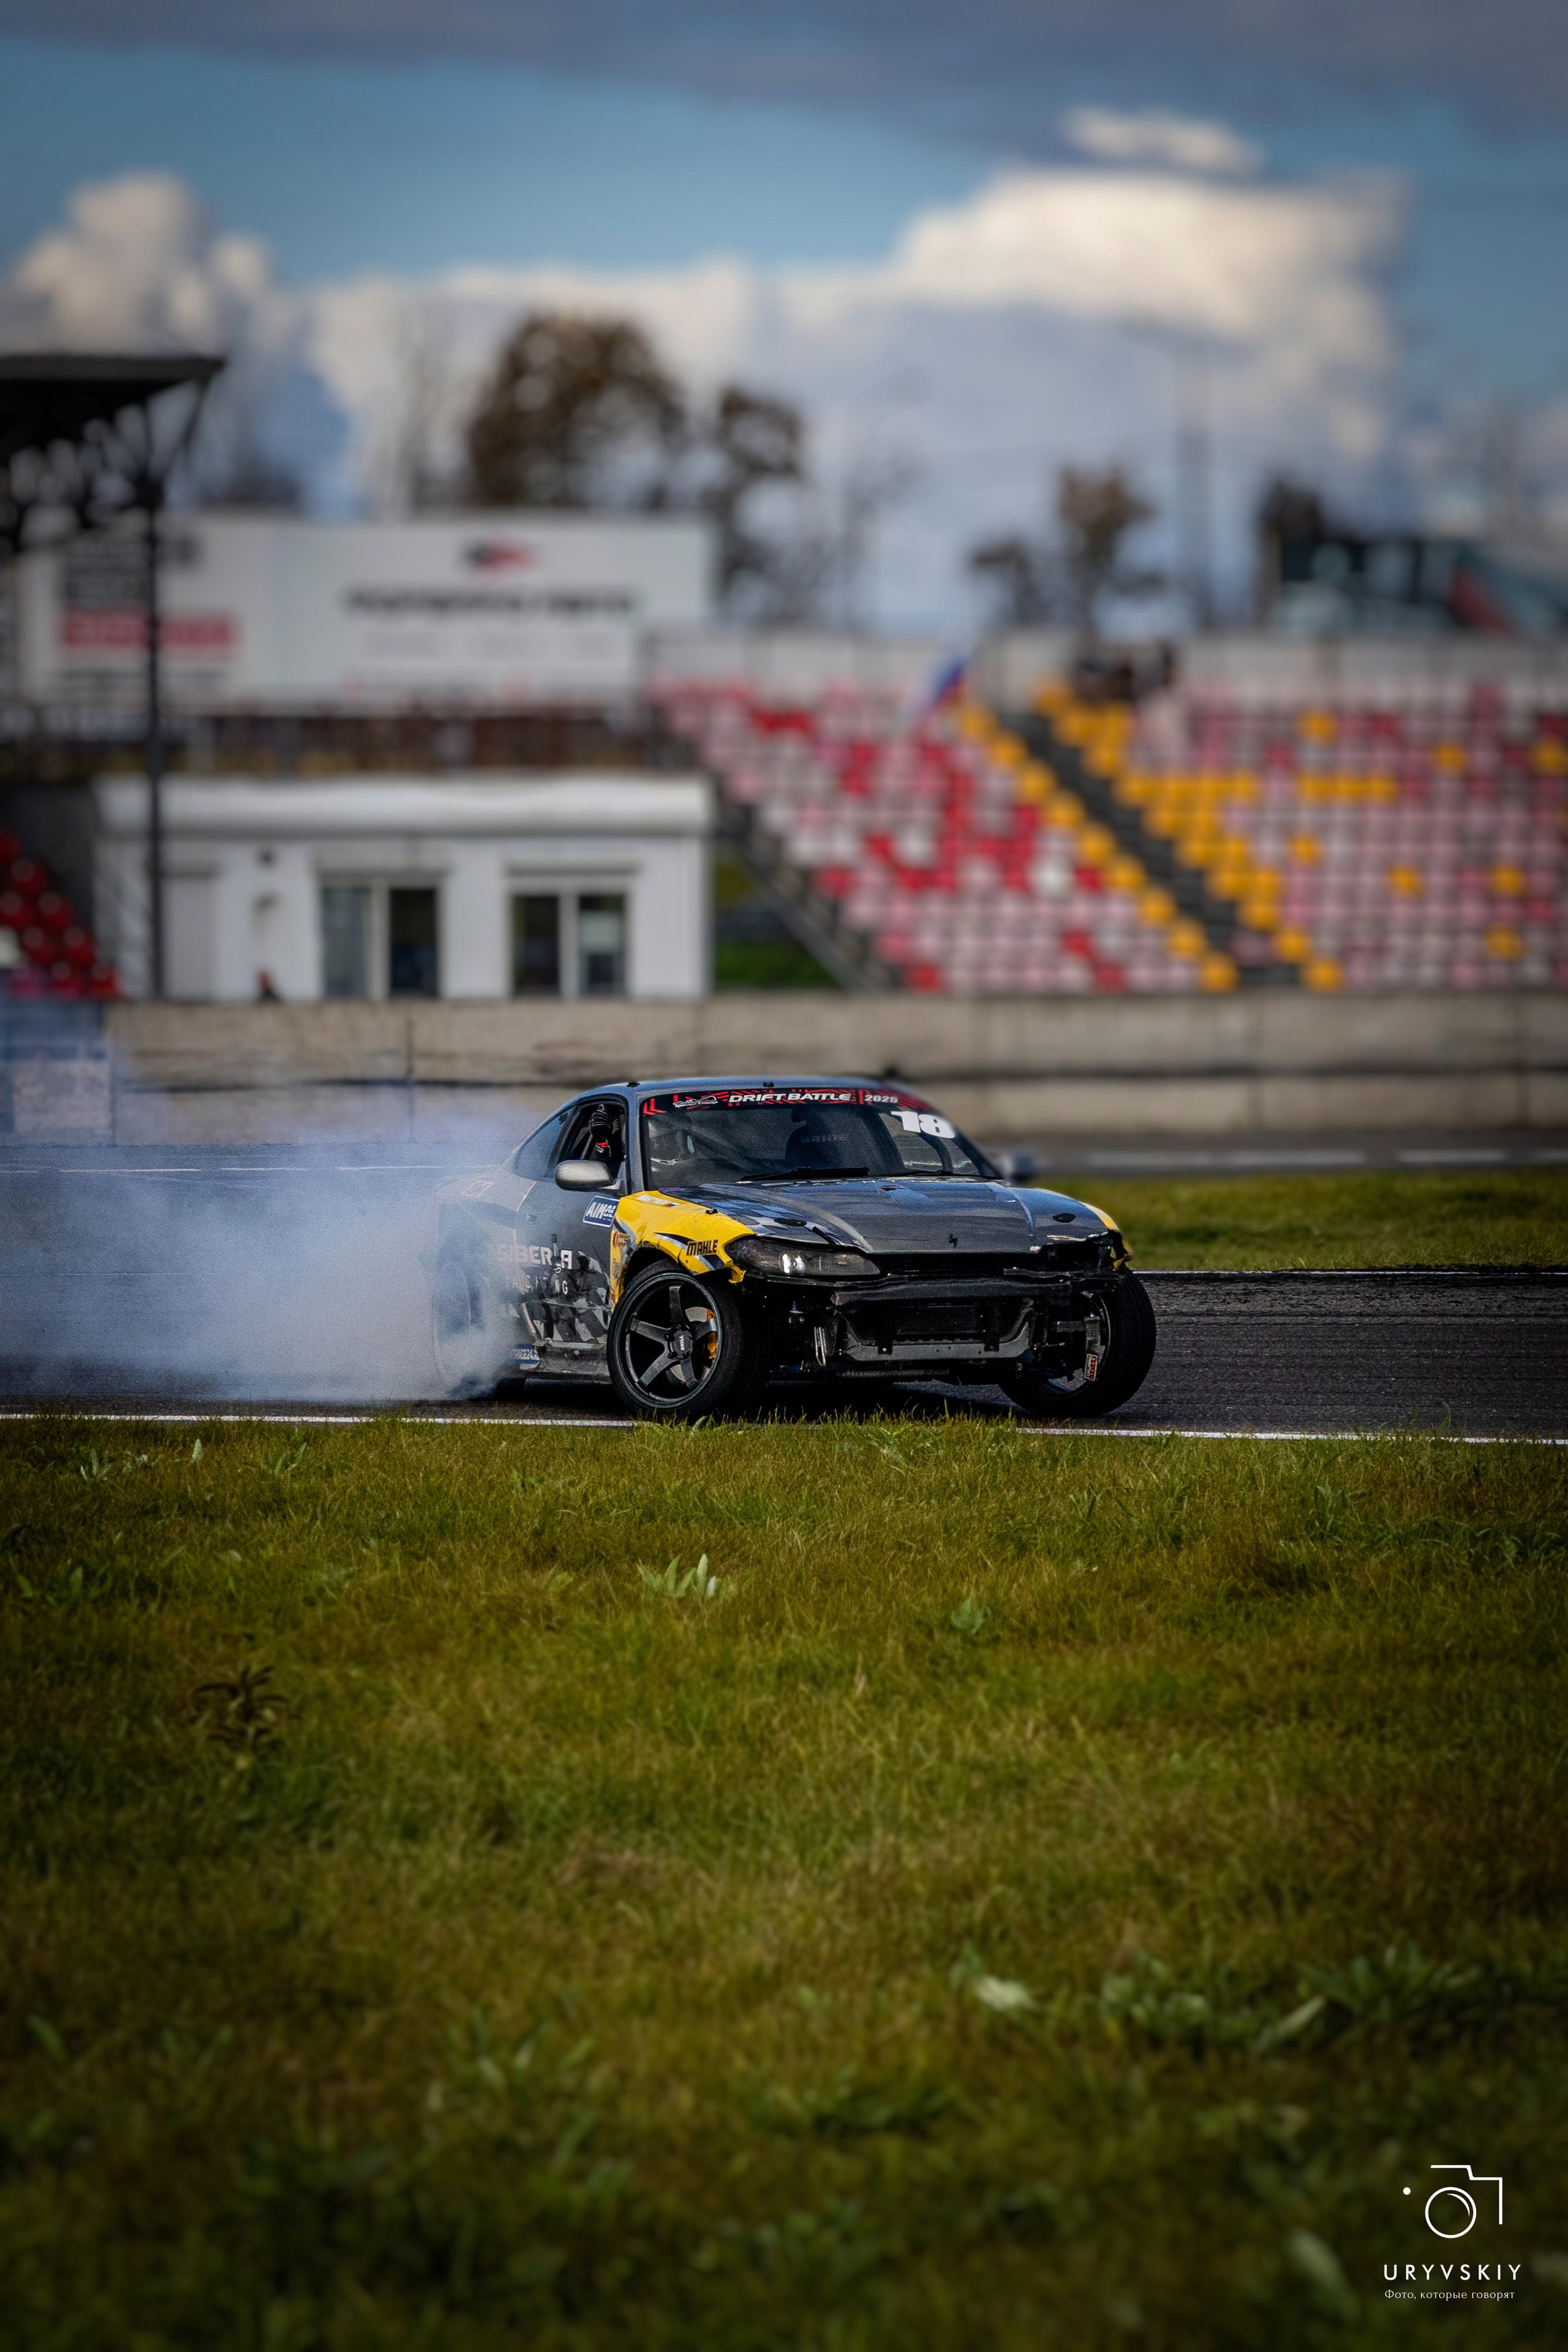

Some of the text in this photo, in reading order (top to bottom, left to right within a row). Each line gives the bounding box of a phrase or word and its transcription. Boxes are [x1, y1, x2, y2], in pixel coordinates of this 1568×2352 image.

[728, 1094, 787, 1102] DRIFT
[864, 1094, 899, 1103] 2025
[891, 1110, 956, 1138] 18
[497, 1243, 573, 1270] SIBERA
[687, 1239, 718, 1255] MAHLE
